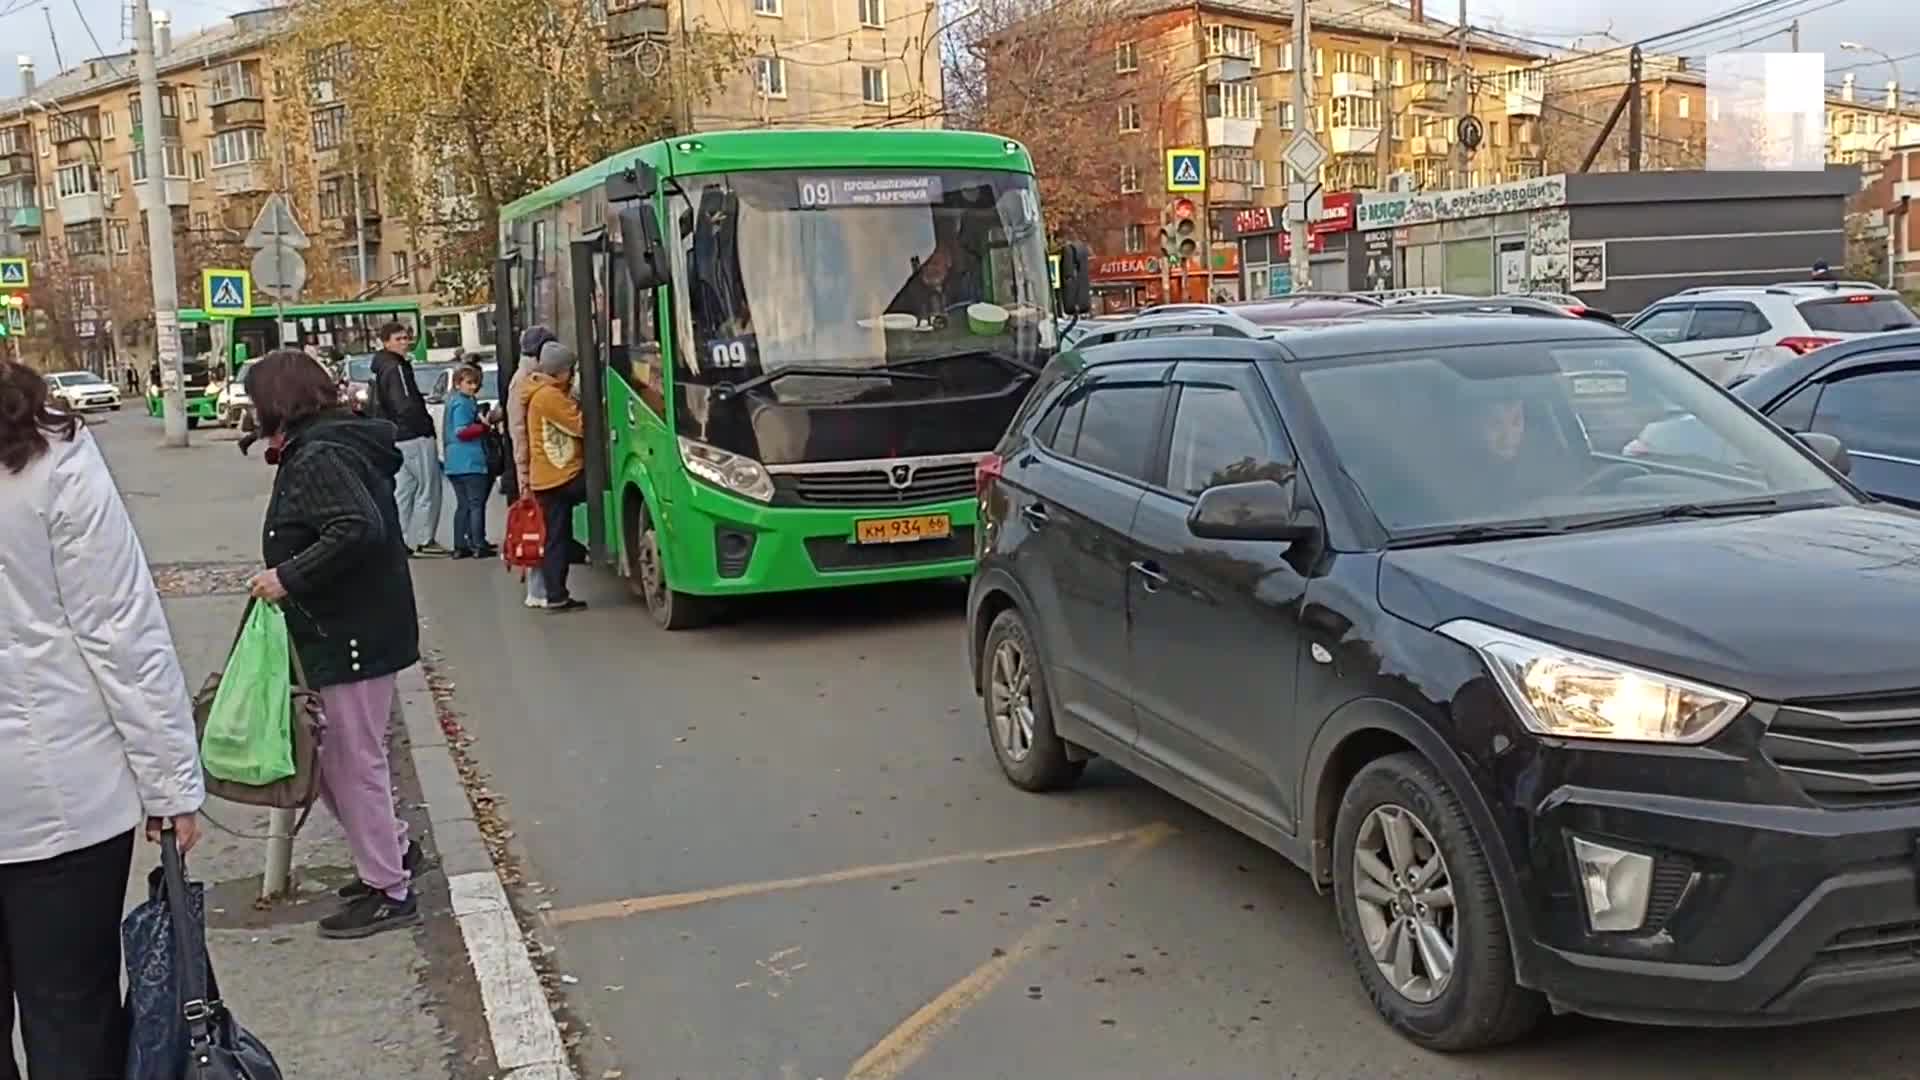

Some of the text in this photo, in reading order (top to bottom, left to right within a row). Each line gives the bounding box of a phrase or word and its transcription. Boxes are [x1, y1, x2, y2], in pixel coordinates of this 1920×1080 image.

[802, 182, 830, 205] 09
[1503, 184, 1546, 202] ОВОЩИ
[1100, 259, 1146, 274] АПТЕКА
[712, 341, 747, 369] 09
[890, 519, 921, 537] 934
[928, 517, 945, 529] 66
